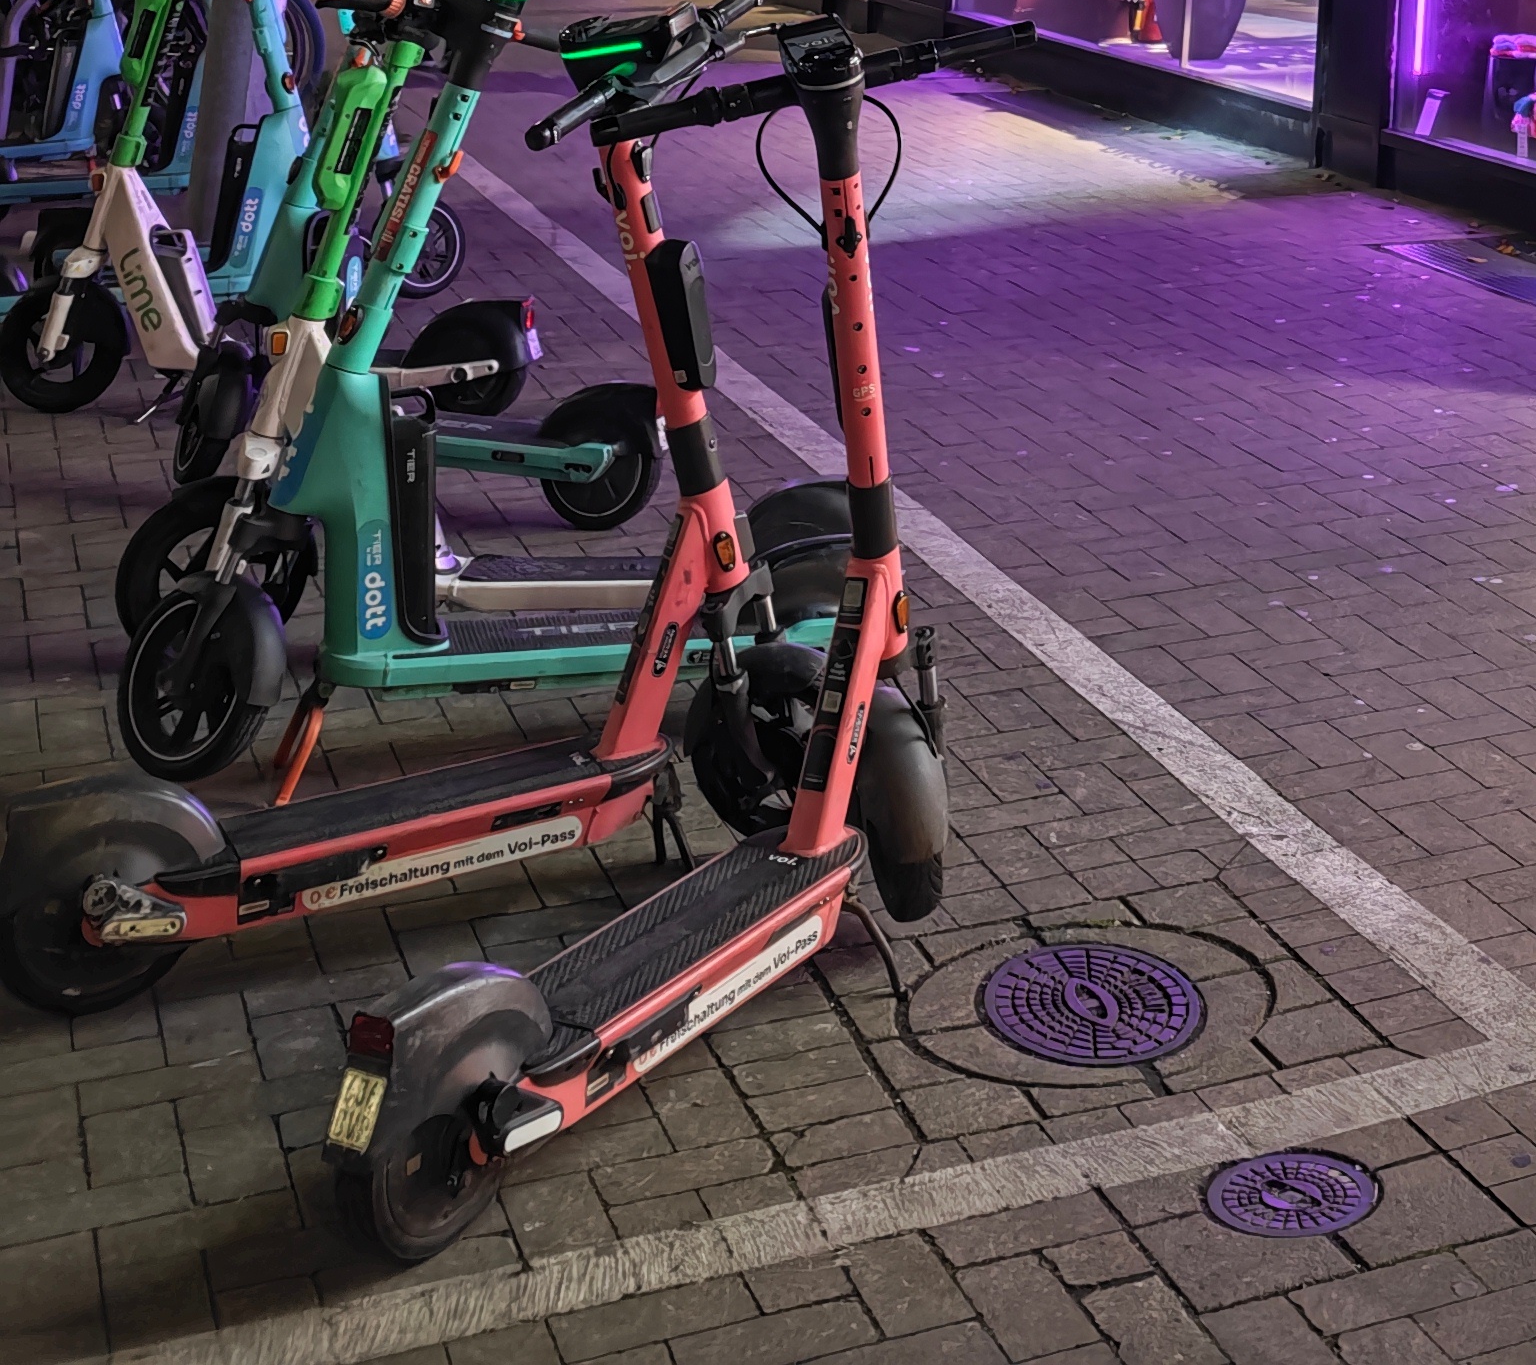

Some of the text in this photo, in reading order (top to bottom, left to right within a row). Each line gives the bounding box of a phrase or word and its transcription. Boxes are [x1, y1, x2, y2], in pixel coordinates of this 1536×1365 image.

[71, 83, 87, 111] dott
[183, 111, 199, 139] dott
[240, 197, 260, 233] dott
[616, 210, 647, 271] voi.
[119, 247, 163, 333] Lime
[852, 385, 876, 398] GPS
[406, 448, 417, 485] TIER
[364, 572, 388, 632] dott
[453, 855, 475, 870] mit
[507, 827, 577, 856] Voi-Pass
[772, 929, 819, 970] Voi-Pass
